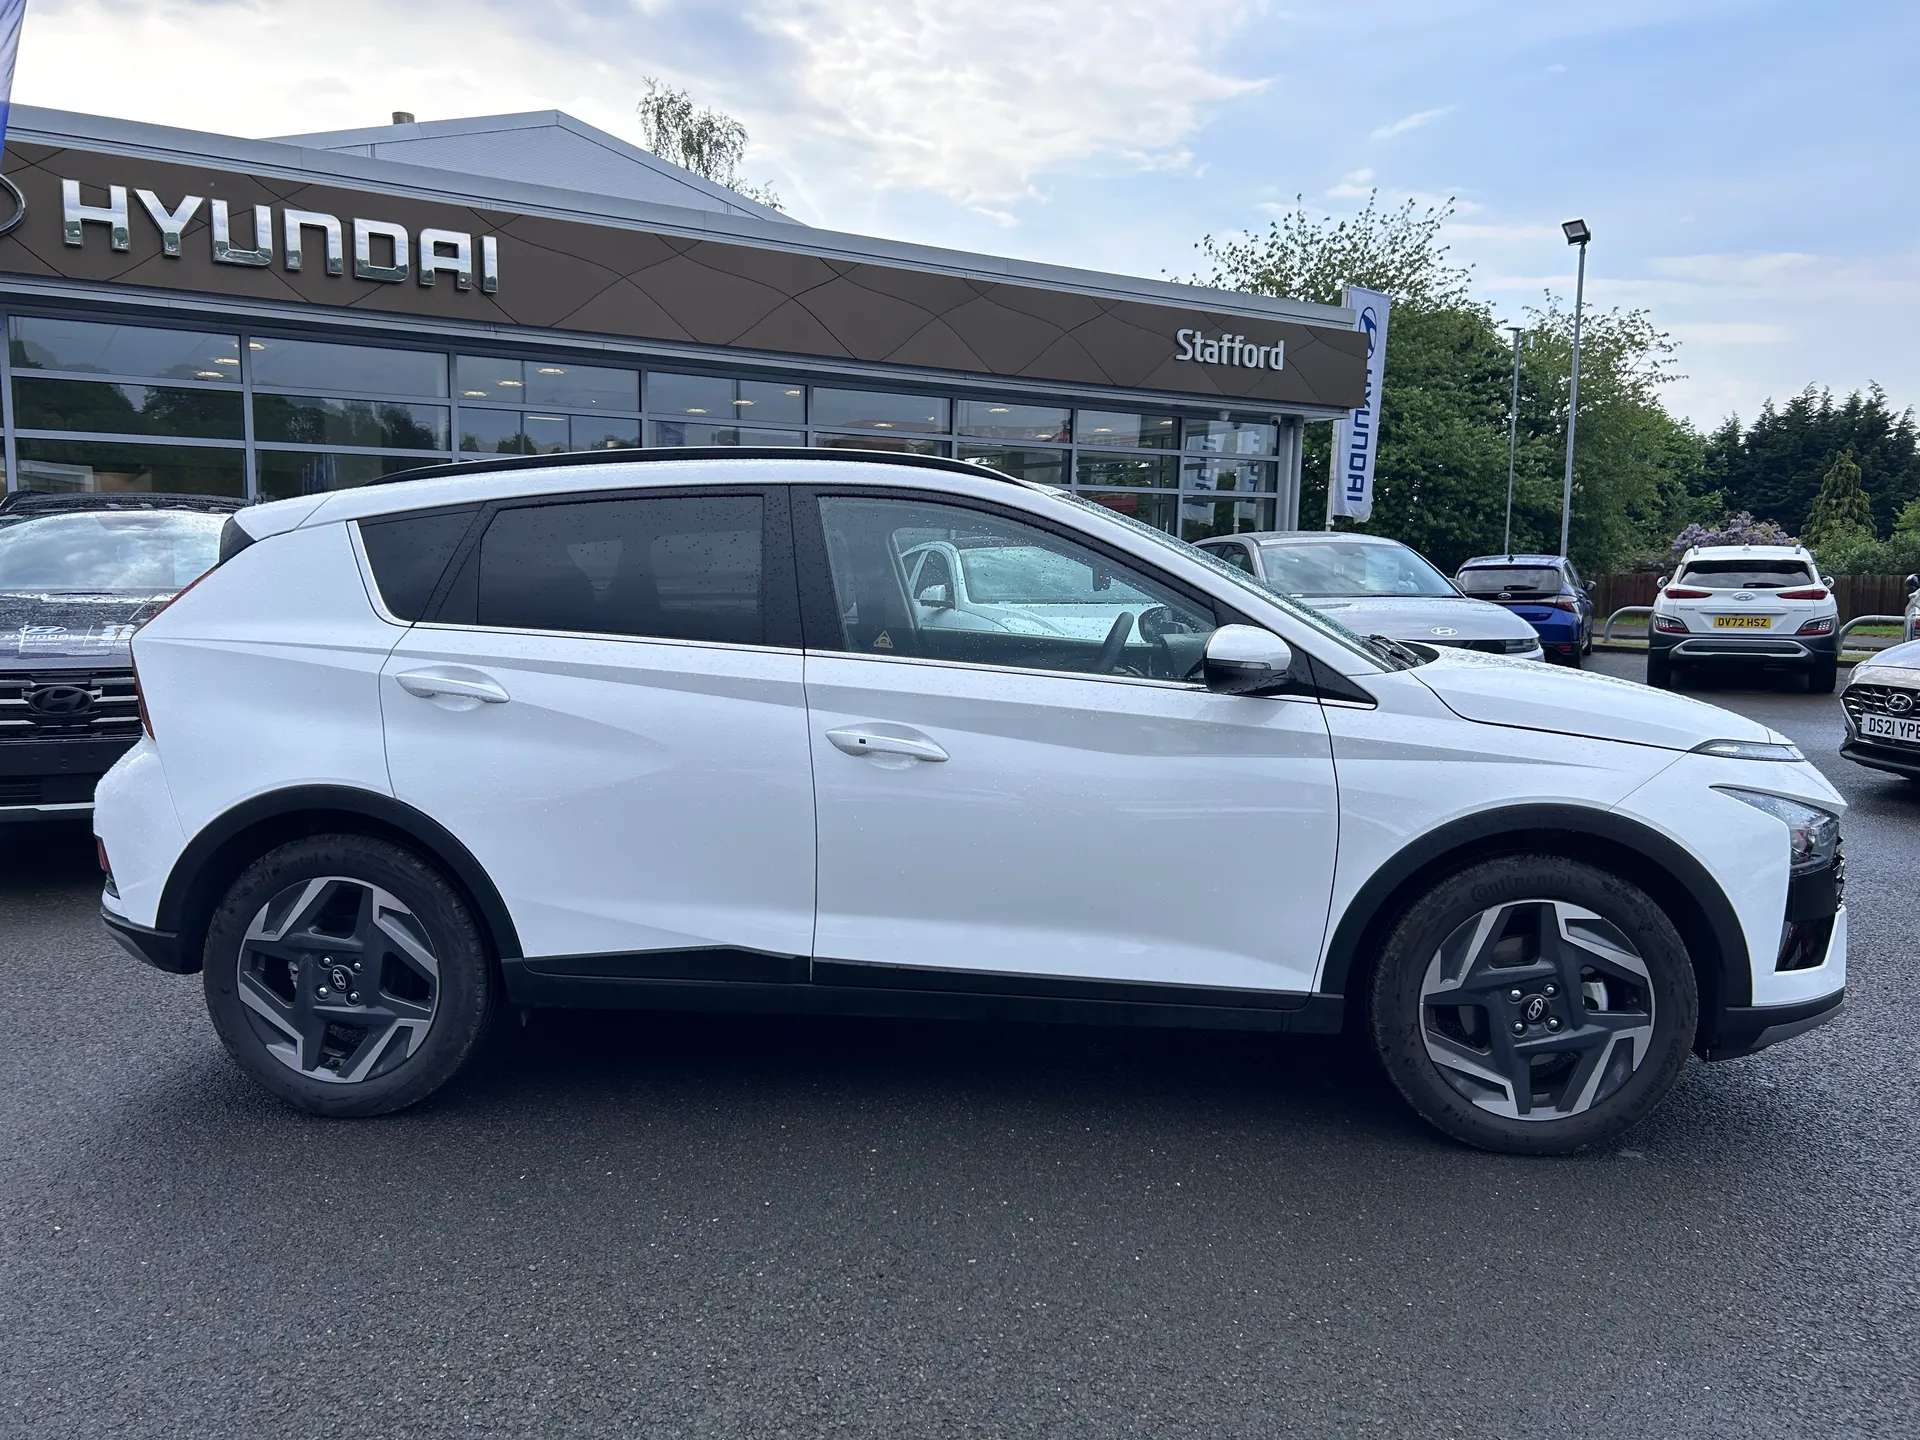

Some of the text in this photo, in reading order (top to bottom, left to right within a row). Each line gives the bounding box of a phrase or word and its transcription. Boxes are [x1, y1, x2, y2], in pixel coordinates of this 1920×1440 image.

[62, 178, 498, 294] HYUNDAI
[1175, 328, 1285, 371] Stafford
[1718, 617, 1767, 627] DV72 HSZ
[1868, 717, 1895, 736] DS21
[1471, 874, 1571, 901] Continental
